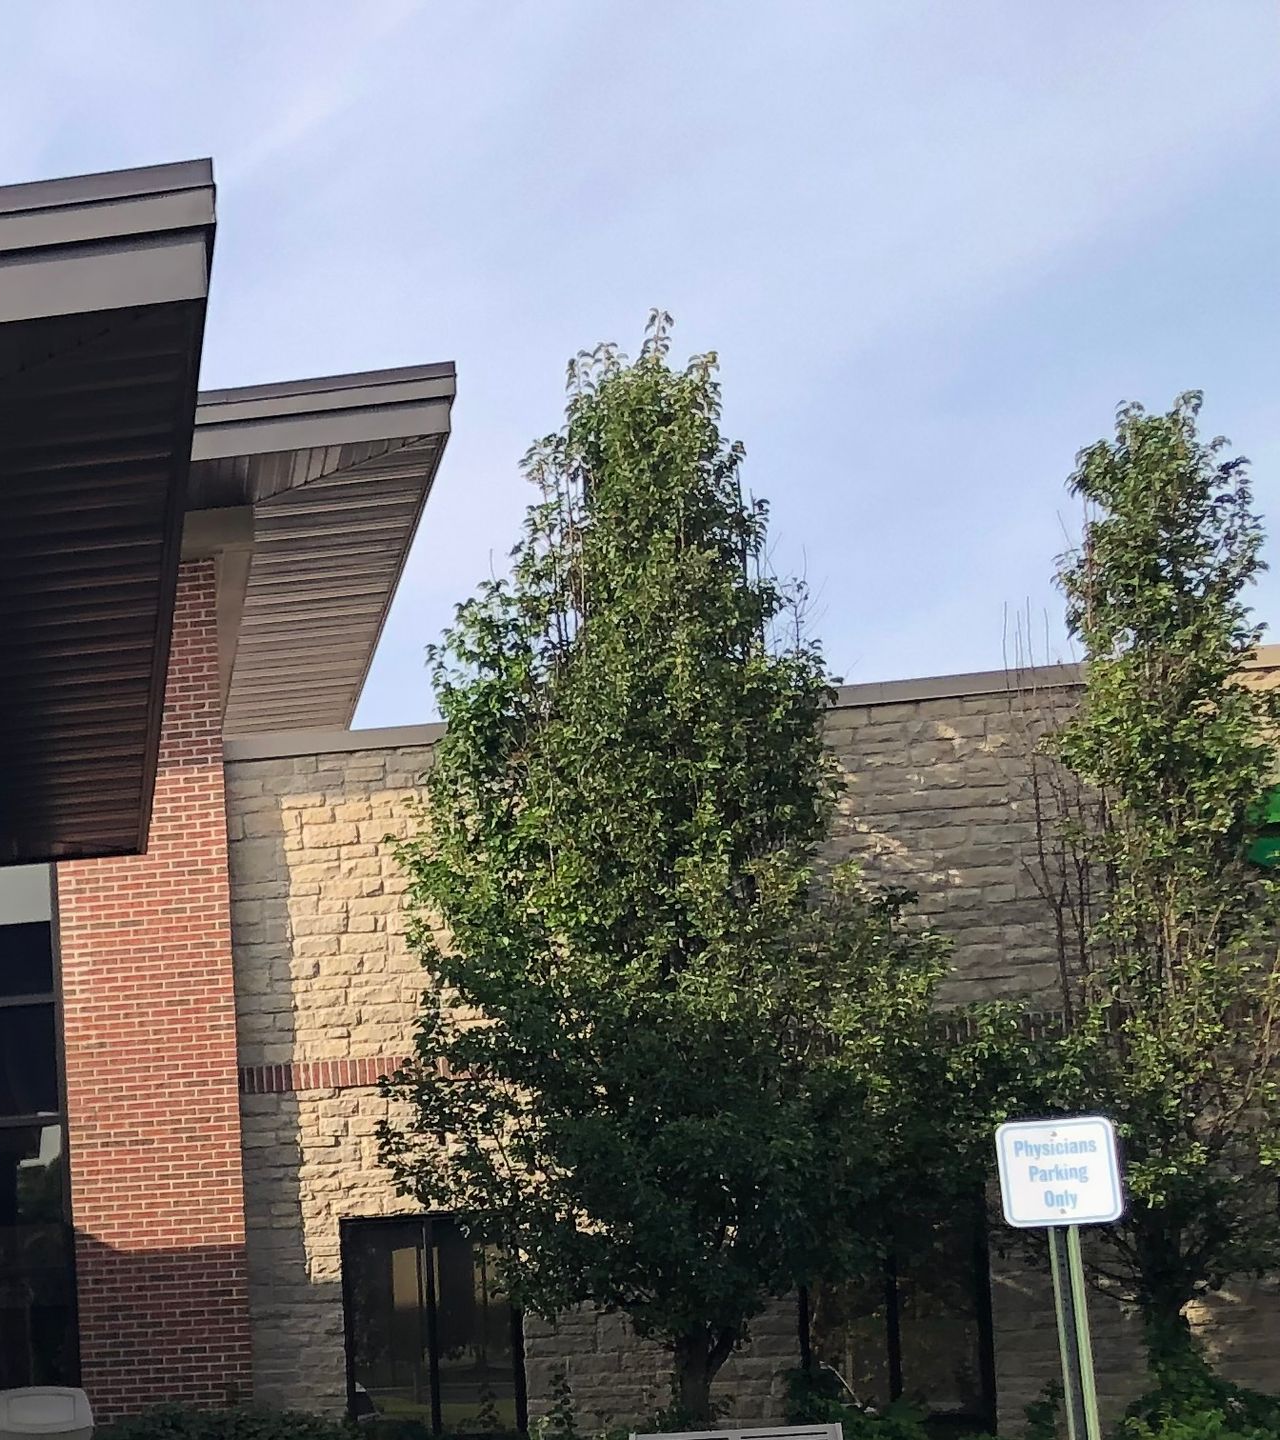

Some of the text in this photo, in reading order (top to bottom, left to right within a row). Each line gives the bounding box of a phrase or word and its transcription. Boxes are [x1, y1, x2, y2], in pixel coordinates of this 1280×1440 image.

[1013, 1138, 1097, 1159] Physicians
[1028, 1164, 1089, 1184] Parking
[1044, 1190, 1078, 1209] Only
